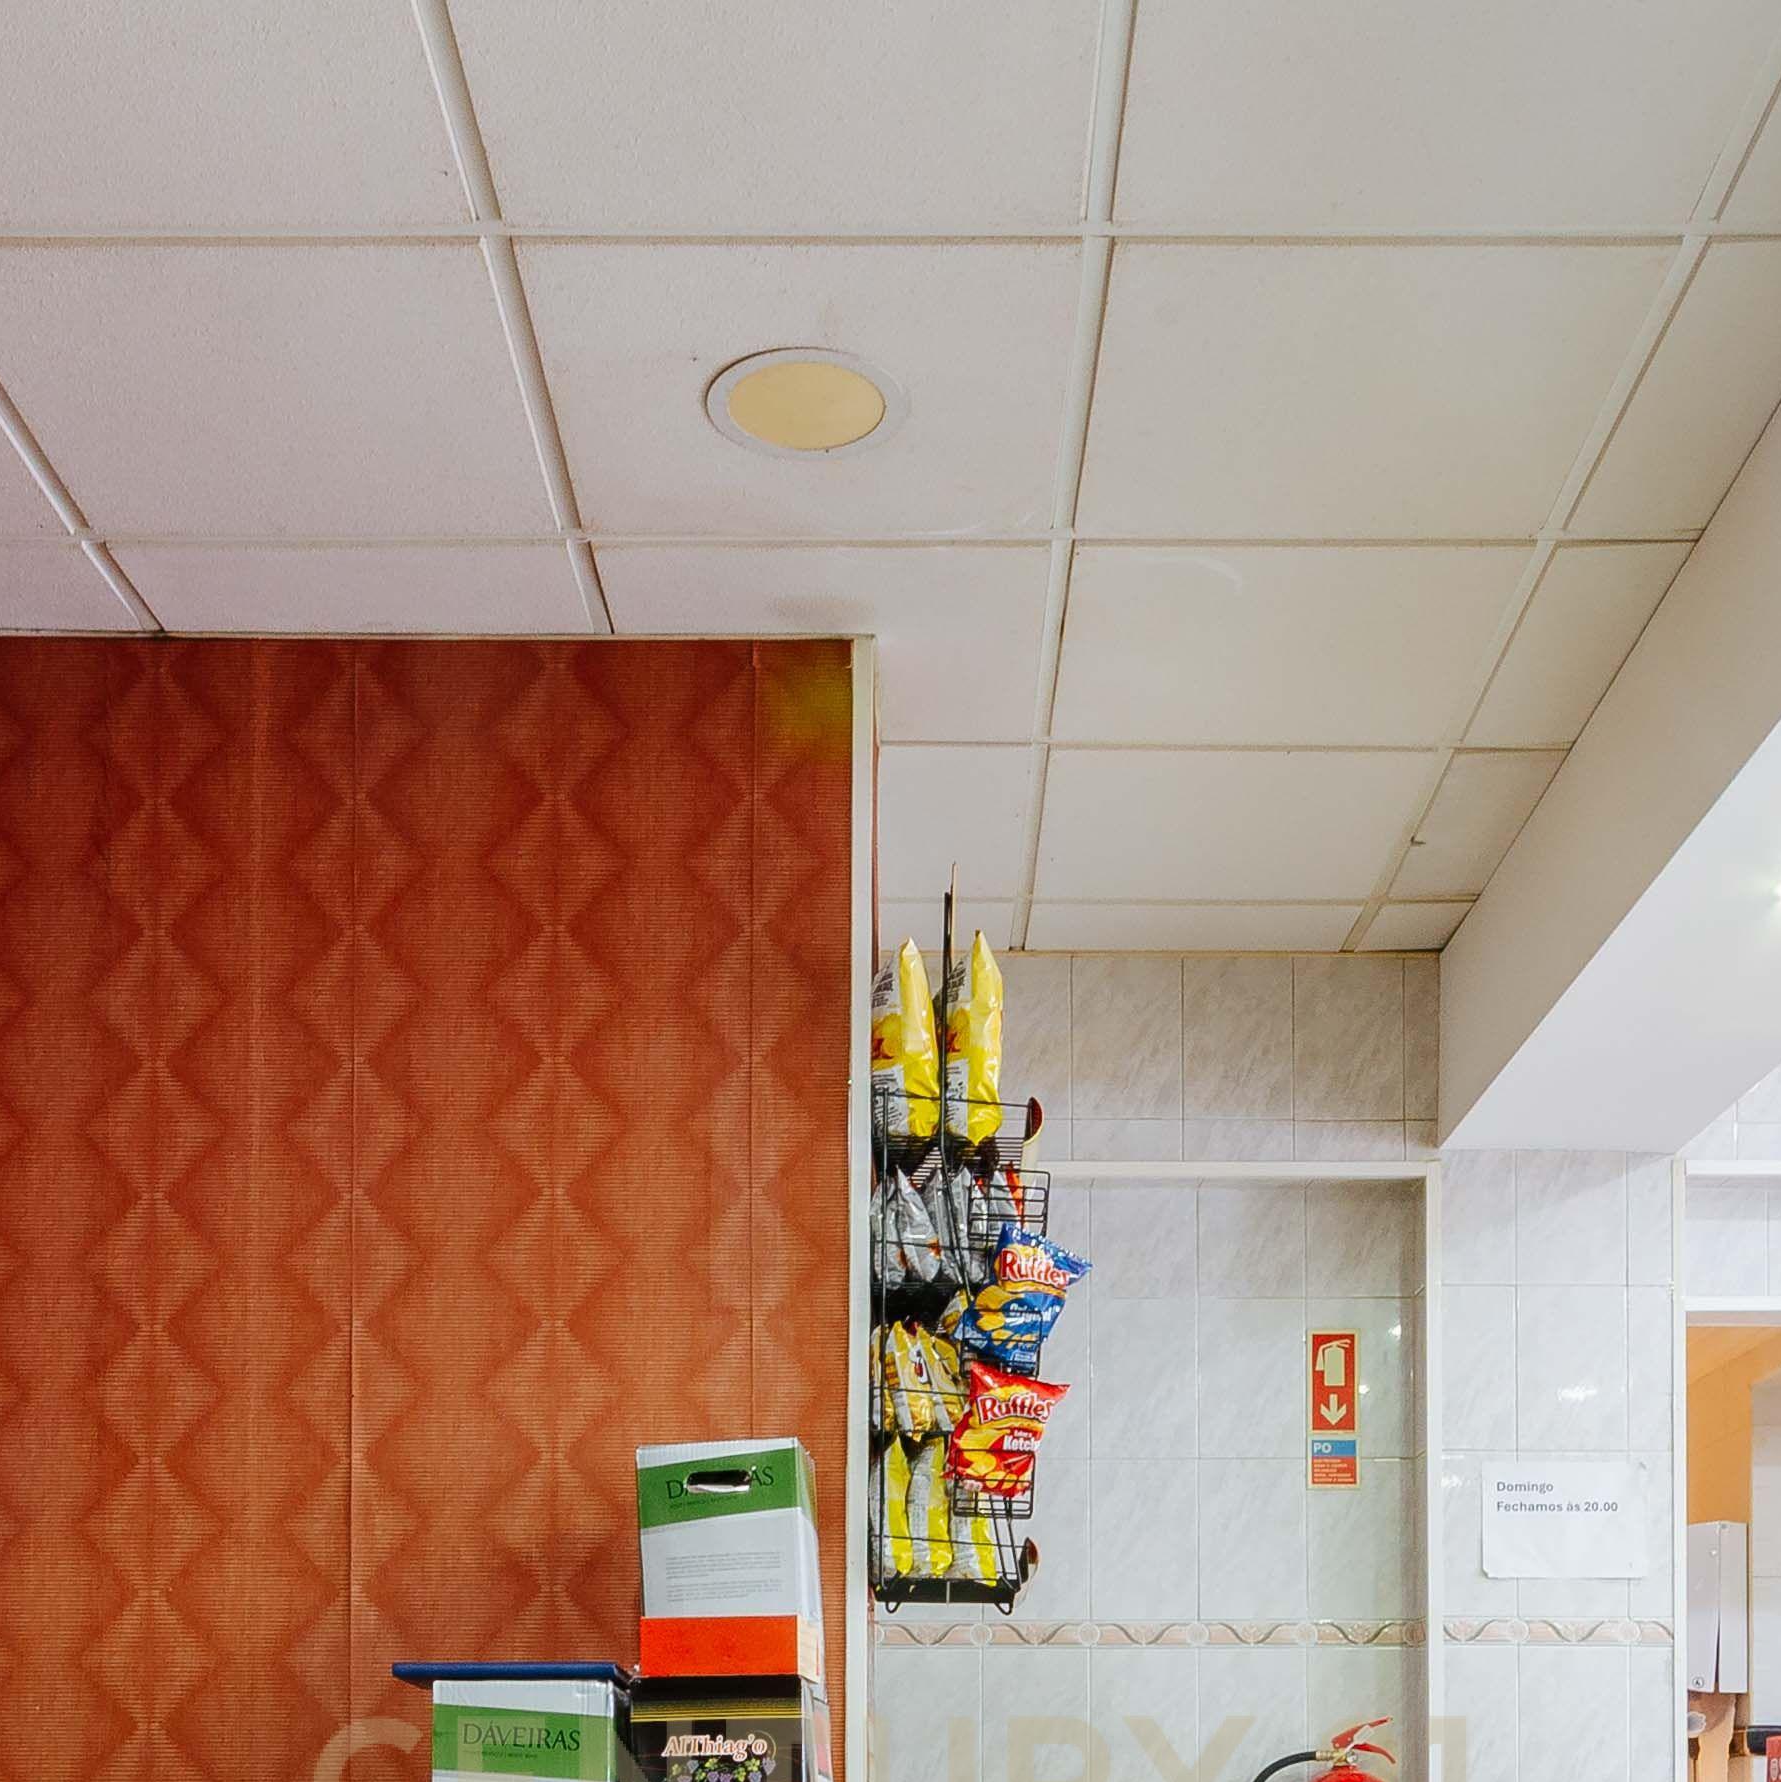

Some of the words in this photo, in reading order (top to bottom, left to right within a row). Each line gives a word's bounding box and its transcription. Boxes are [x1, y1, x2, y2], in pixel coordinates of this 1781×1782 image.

[1000, 1248, 1071, 1289] Ruffles
[977, 1395, 1056, 1424] Ruffles
[1313, 1442, 1333, 1453] PO
[1496, 1481, 1554, 1494] Domingo
[1496, 1501, 1563, 1512] Fechamos
[1584, 1501, 1619, 1512] 20.00
[462, 1720, 581, 1752] DÁVEIRAS
